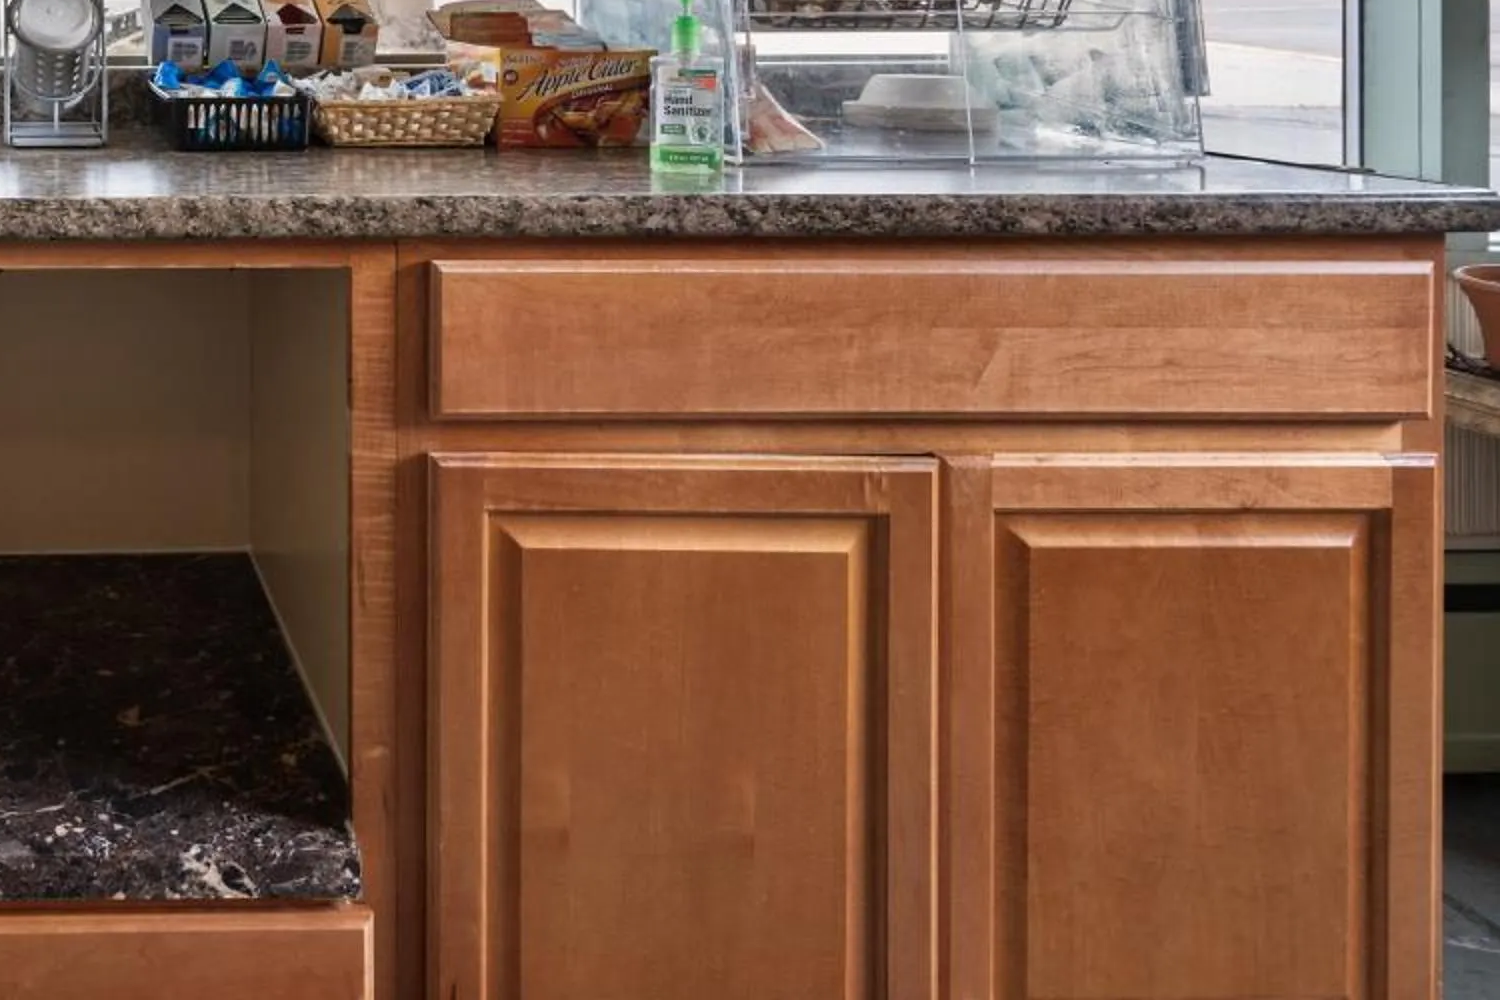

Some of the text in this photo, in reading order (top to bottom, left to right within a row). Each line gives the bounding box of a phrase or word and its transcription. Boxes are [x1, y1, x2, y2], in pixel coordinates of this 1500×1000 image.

[516, 56, 637, 101] Apple Cider
[664, 95, 692, 105] Hand
[664, 105, 711, 116] Sanitizer
